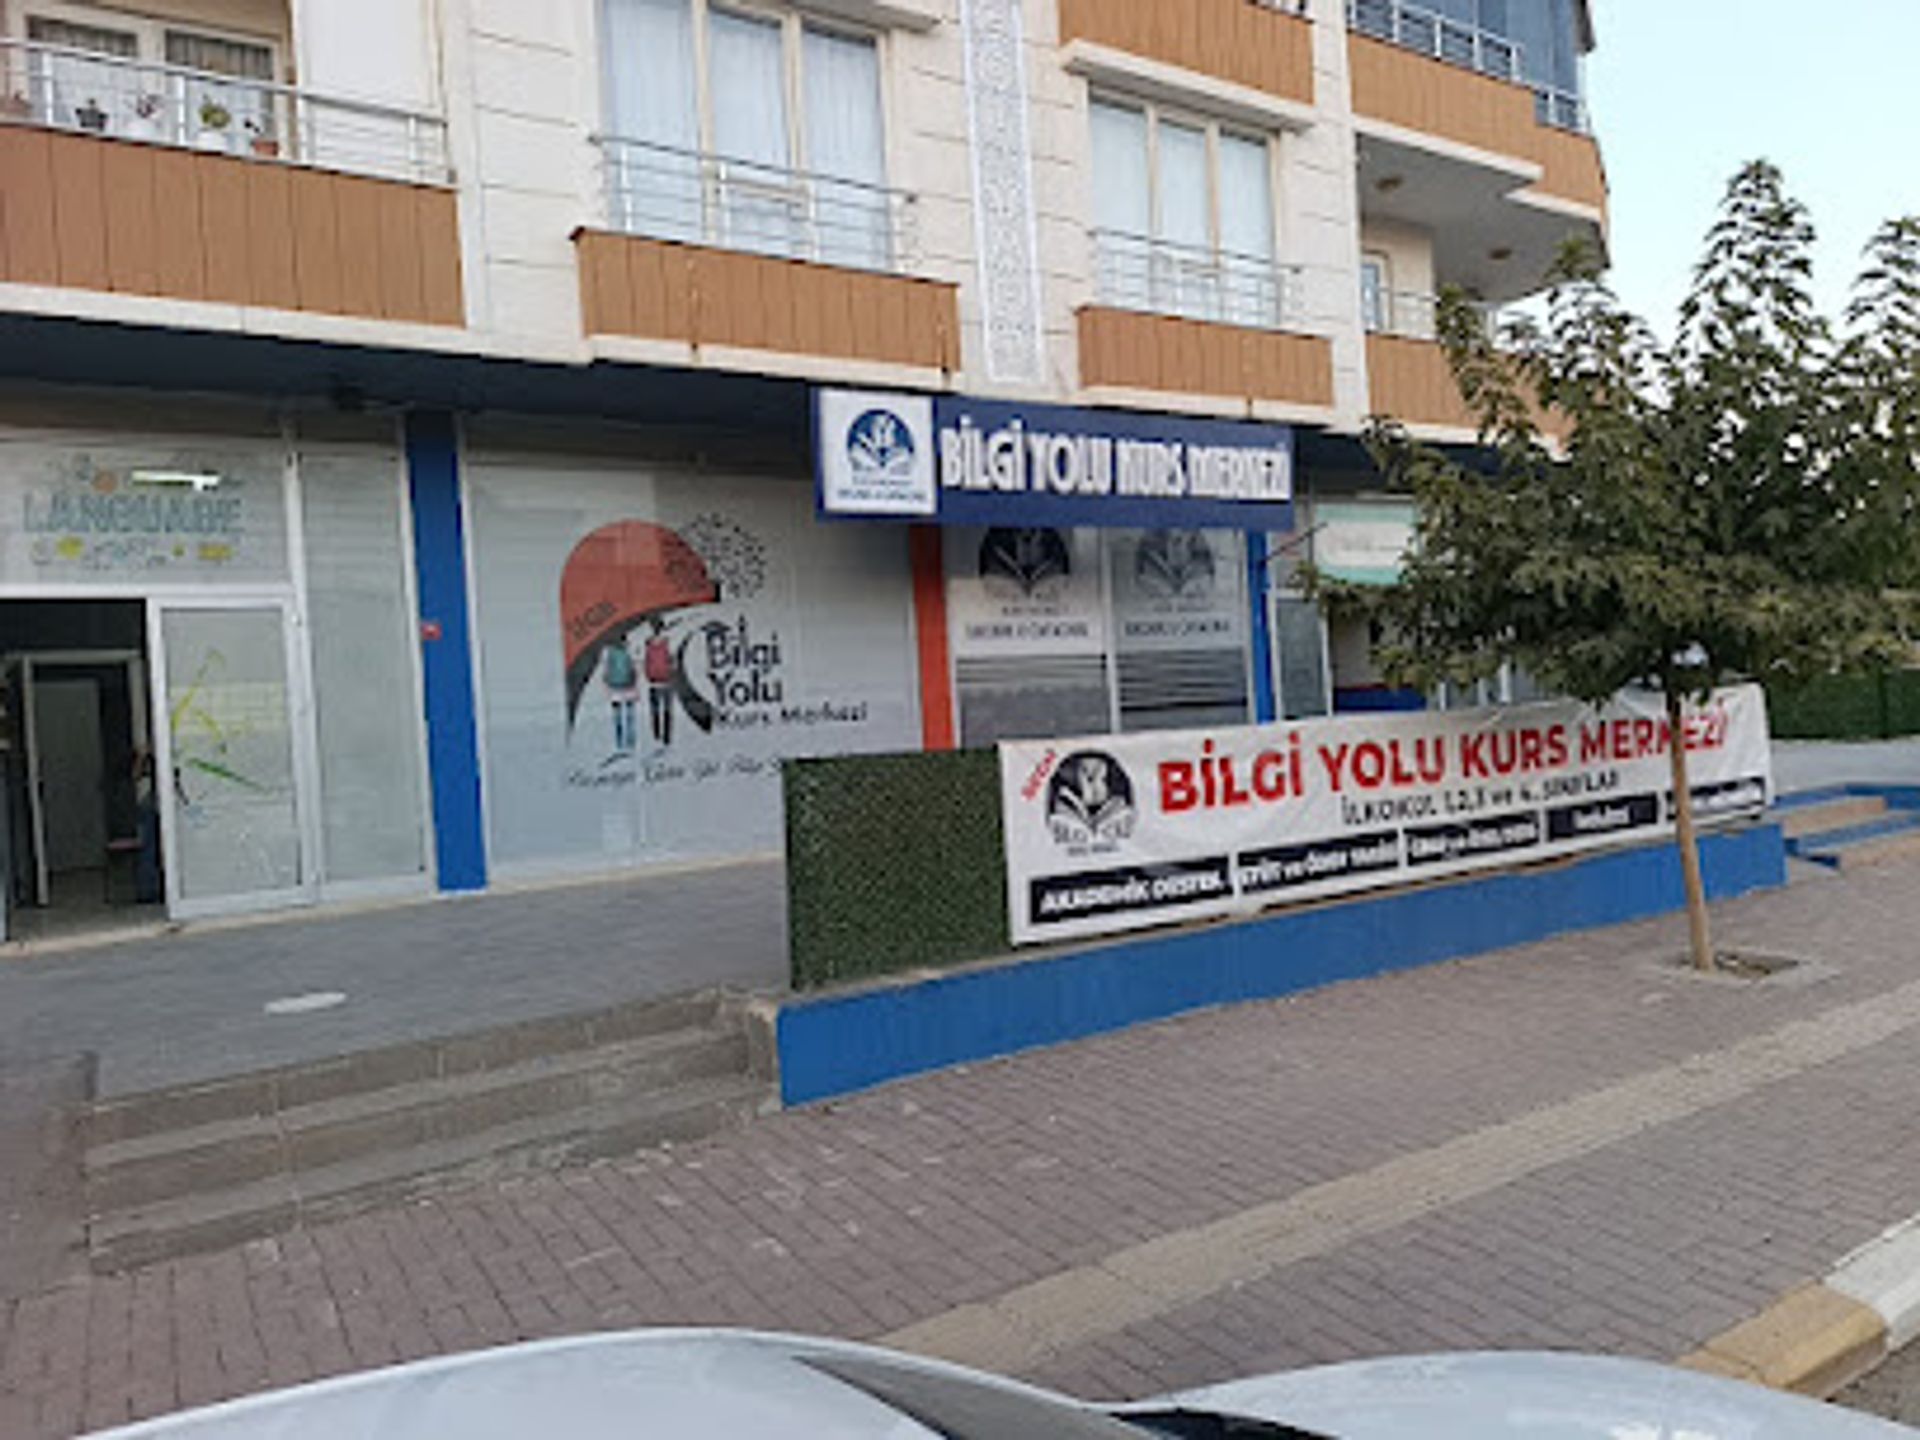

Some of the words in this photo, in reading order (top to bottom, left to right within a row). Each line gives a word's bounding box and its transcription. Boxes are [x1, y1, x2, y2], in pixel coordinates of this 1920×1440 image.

[940, 414, 1026, 491] BİLGİ
[1029, 432, 1113, 495] YOLU
[705, 614, 782, 674] Bilgi
[707, 668, 783, 706] Yolu
[1157, 731, 1303, 813] BİLGİ
[1318, 737, 1448, 792] YOLU
[1459, 723, 1569, 780] KURS
